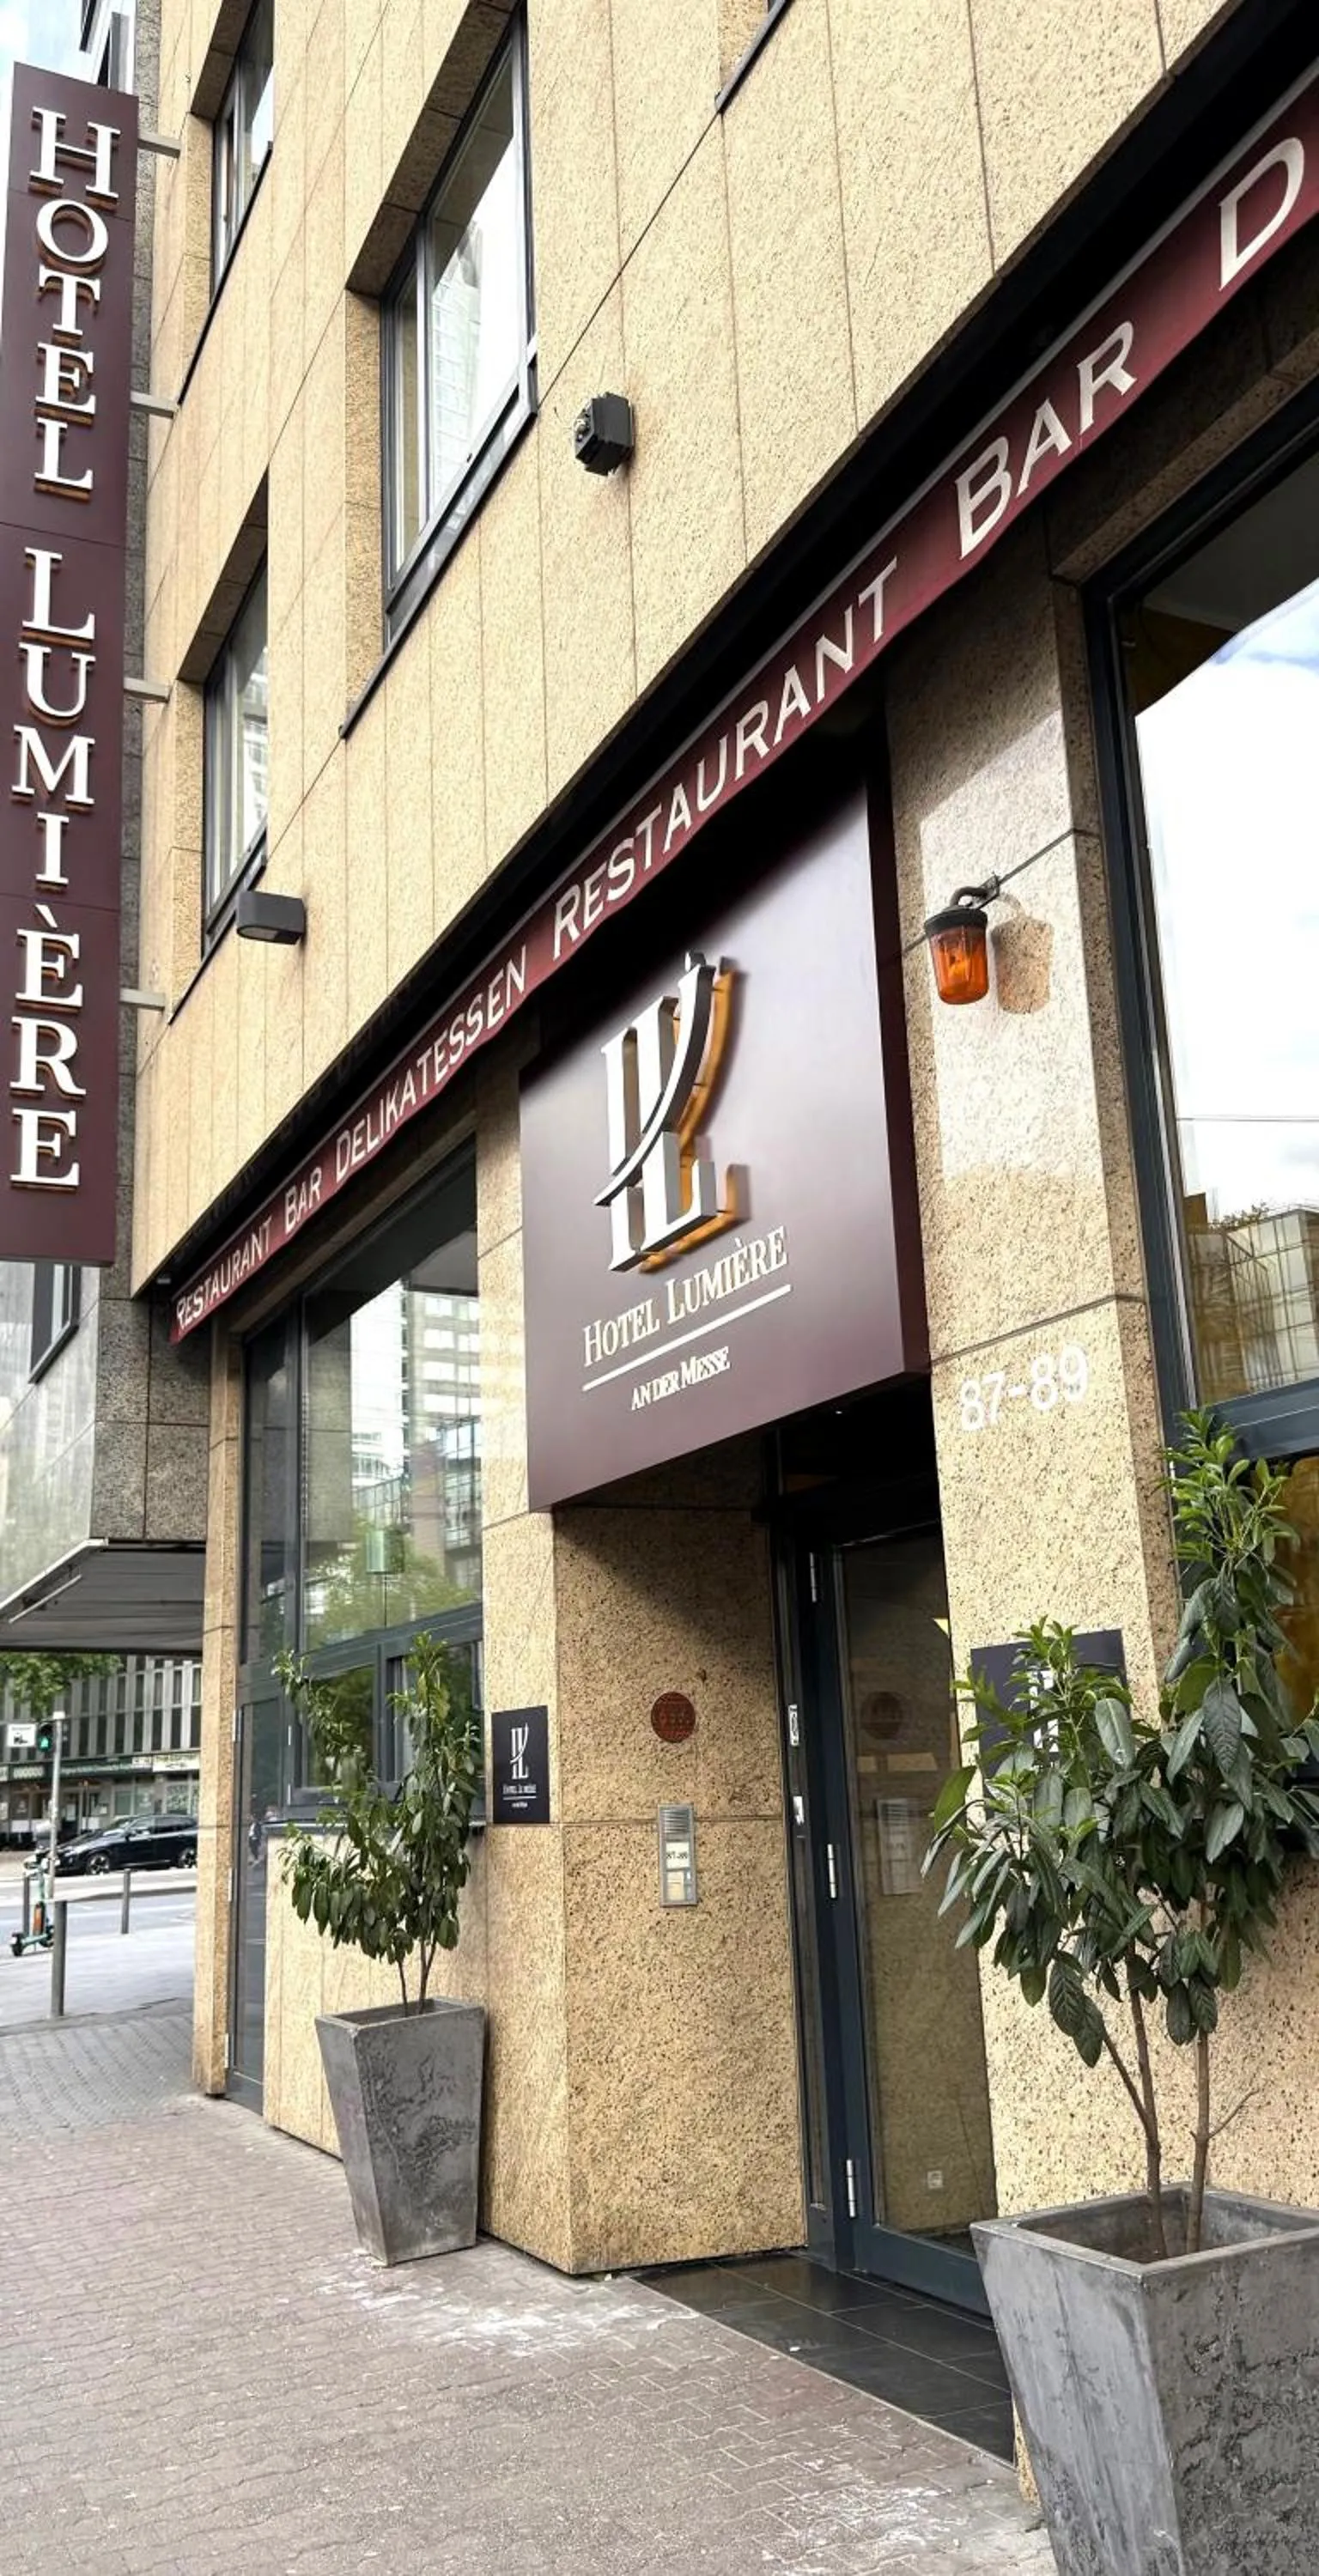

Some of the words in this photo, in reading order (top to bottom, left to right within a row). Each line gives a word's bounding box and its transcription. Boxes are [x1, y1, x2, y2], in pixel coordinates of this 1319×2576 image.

[27, 106, 122, 492] HOTEL
[9, 546, 96, 1188] LUMIÈRE
[176, 1216, 272, 1330] RESTAURANT
[285, 1166, 323, 1235] BAR
[336, 944, 527, 1184] DELIKATESSEN
[552, 556, 897, 961] RESTAURANT
[954, 320, 1138, 560] BAR
[582, 1298, 660, 1368] HOTEL
[665, 1224, 788, 1325] LUMIÈRE
[631, 1381, 652, 1411] AN
[652, 1370, 681, 1402] DER
[680, 1346, 731, 1390] MESSE
[960, 1343, 1089, 1432] 87-89
